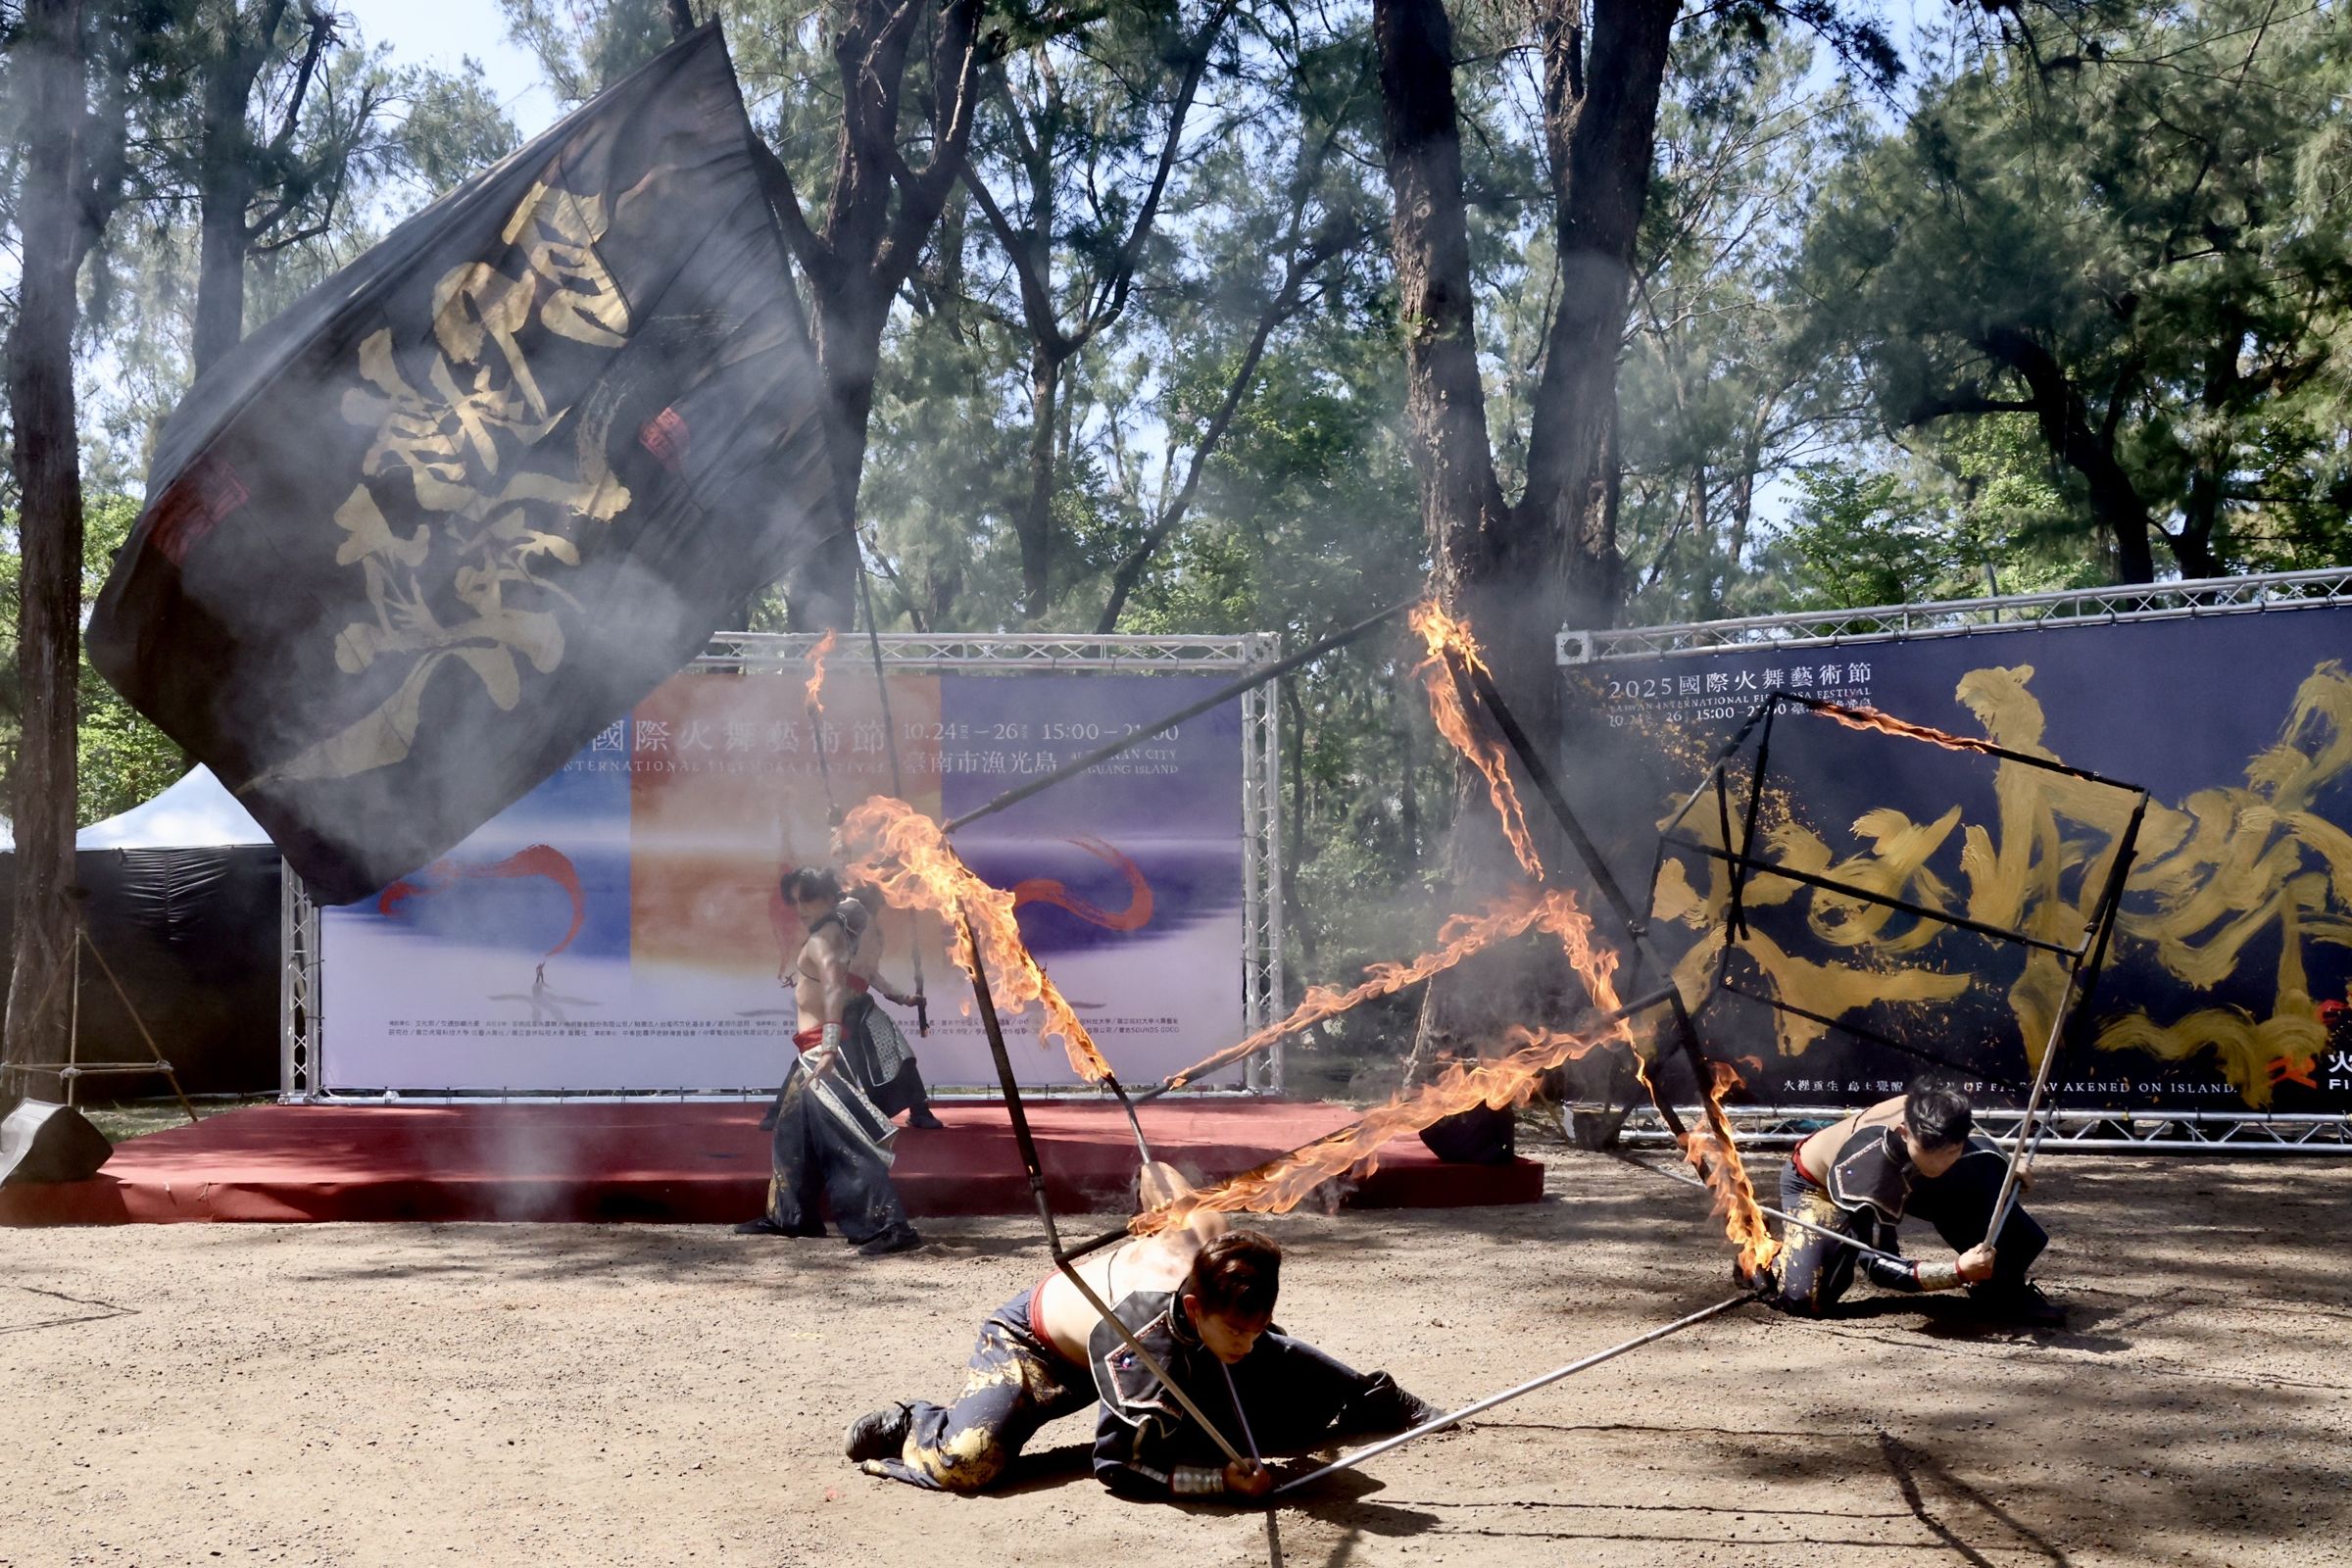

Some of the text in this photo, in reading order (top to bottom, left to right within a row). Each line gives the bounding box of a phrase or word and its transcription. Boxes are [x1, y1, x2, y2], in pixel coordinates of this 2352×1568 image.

[1655, 695, 1749, 711] INTERNATIONAL
[1753, 691, 1812, 703] FISA
[1817, 687, 1873, 700] FESTIVAL
[1695, 707, 1736, 721] 15:00
[1043, 723, 1099, 740] 15:00
[1145, 749, 1177, 760] CITY
[1135, 764, 1179, 775] ISLAND
[1963, 1081, 1984, 1093] OF
[2139, 1082, 2163, 1093] ON
[2171, 1082, 2237, 1094] ISLAND.
